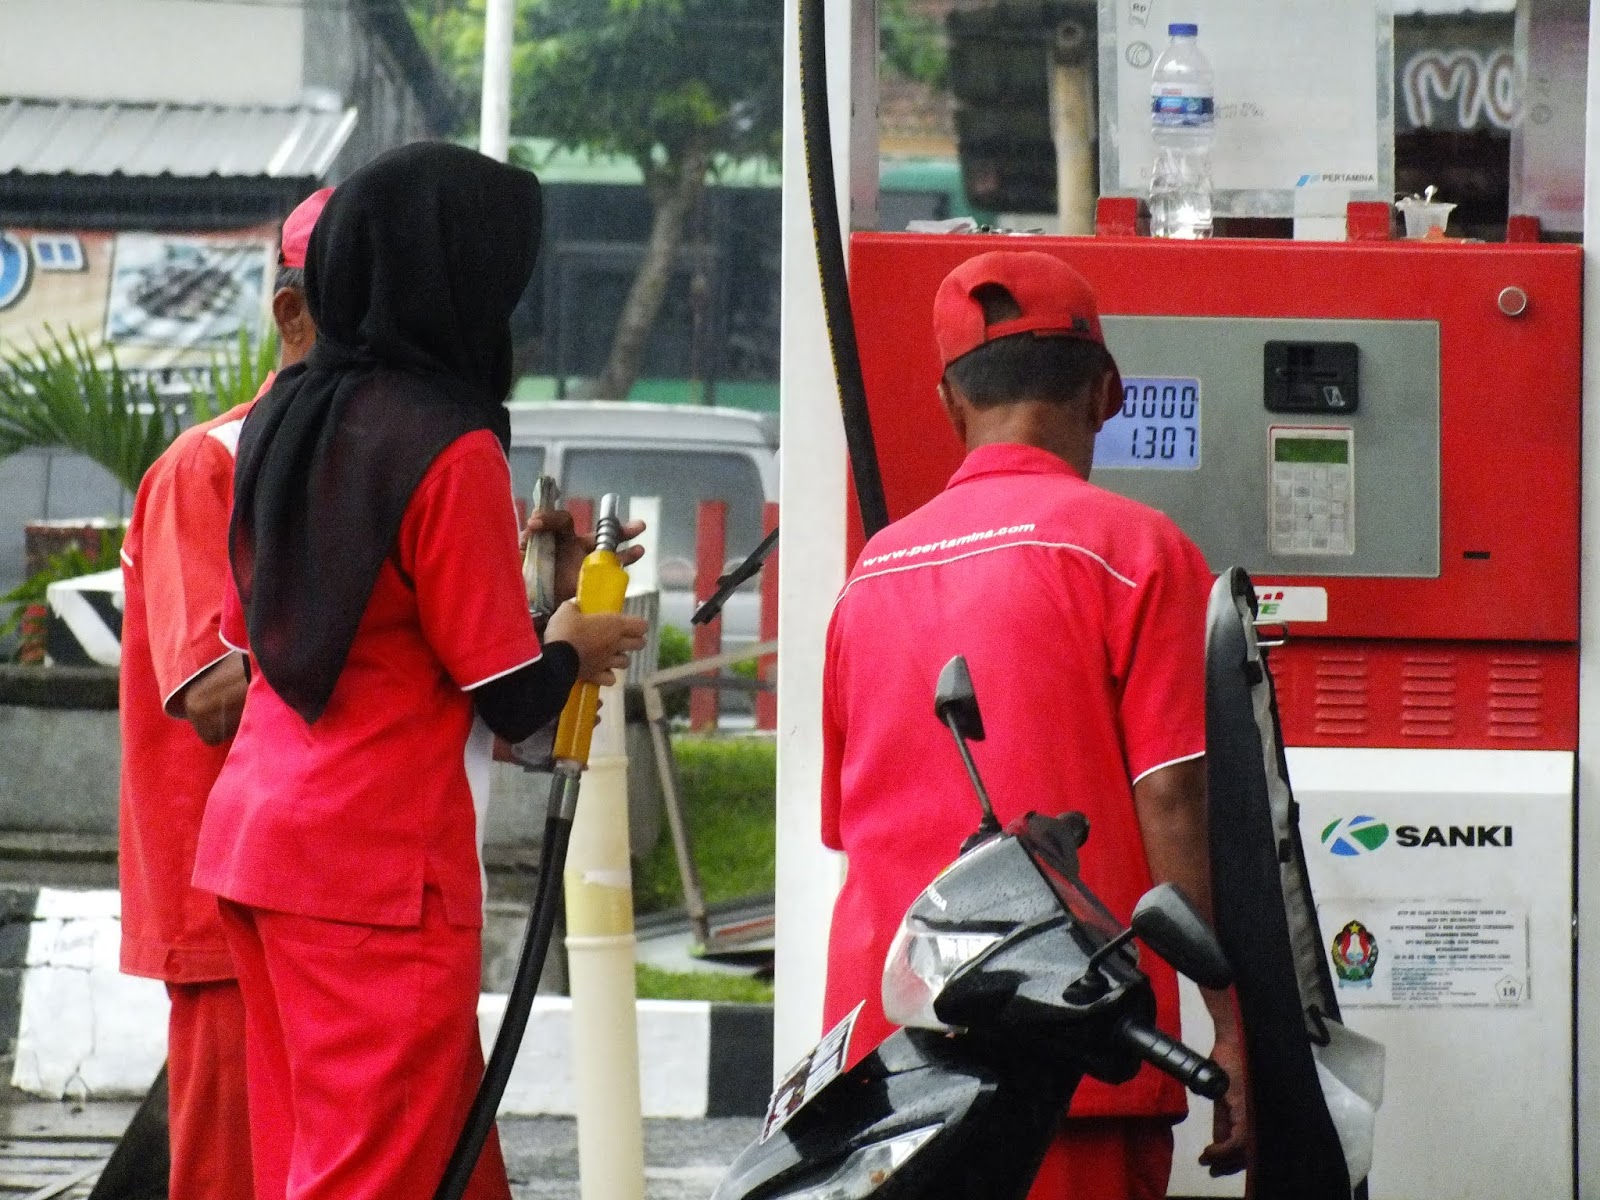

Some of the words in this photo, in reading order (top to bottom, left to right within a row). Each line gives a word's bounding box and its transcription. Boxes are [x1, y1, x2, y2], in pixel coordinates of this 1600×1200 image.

[1321, 174, 1375, 182] PERTAMINA
[1131, 426, 1196, 459] 1.307
[862, 522, 1036, 568] www.pertamina.com
[1395, 825, 1513, 847] SANKI
